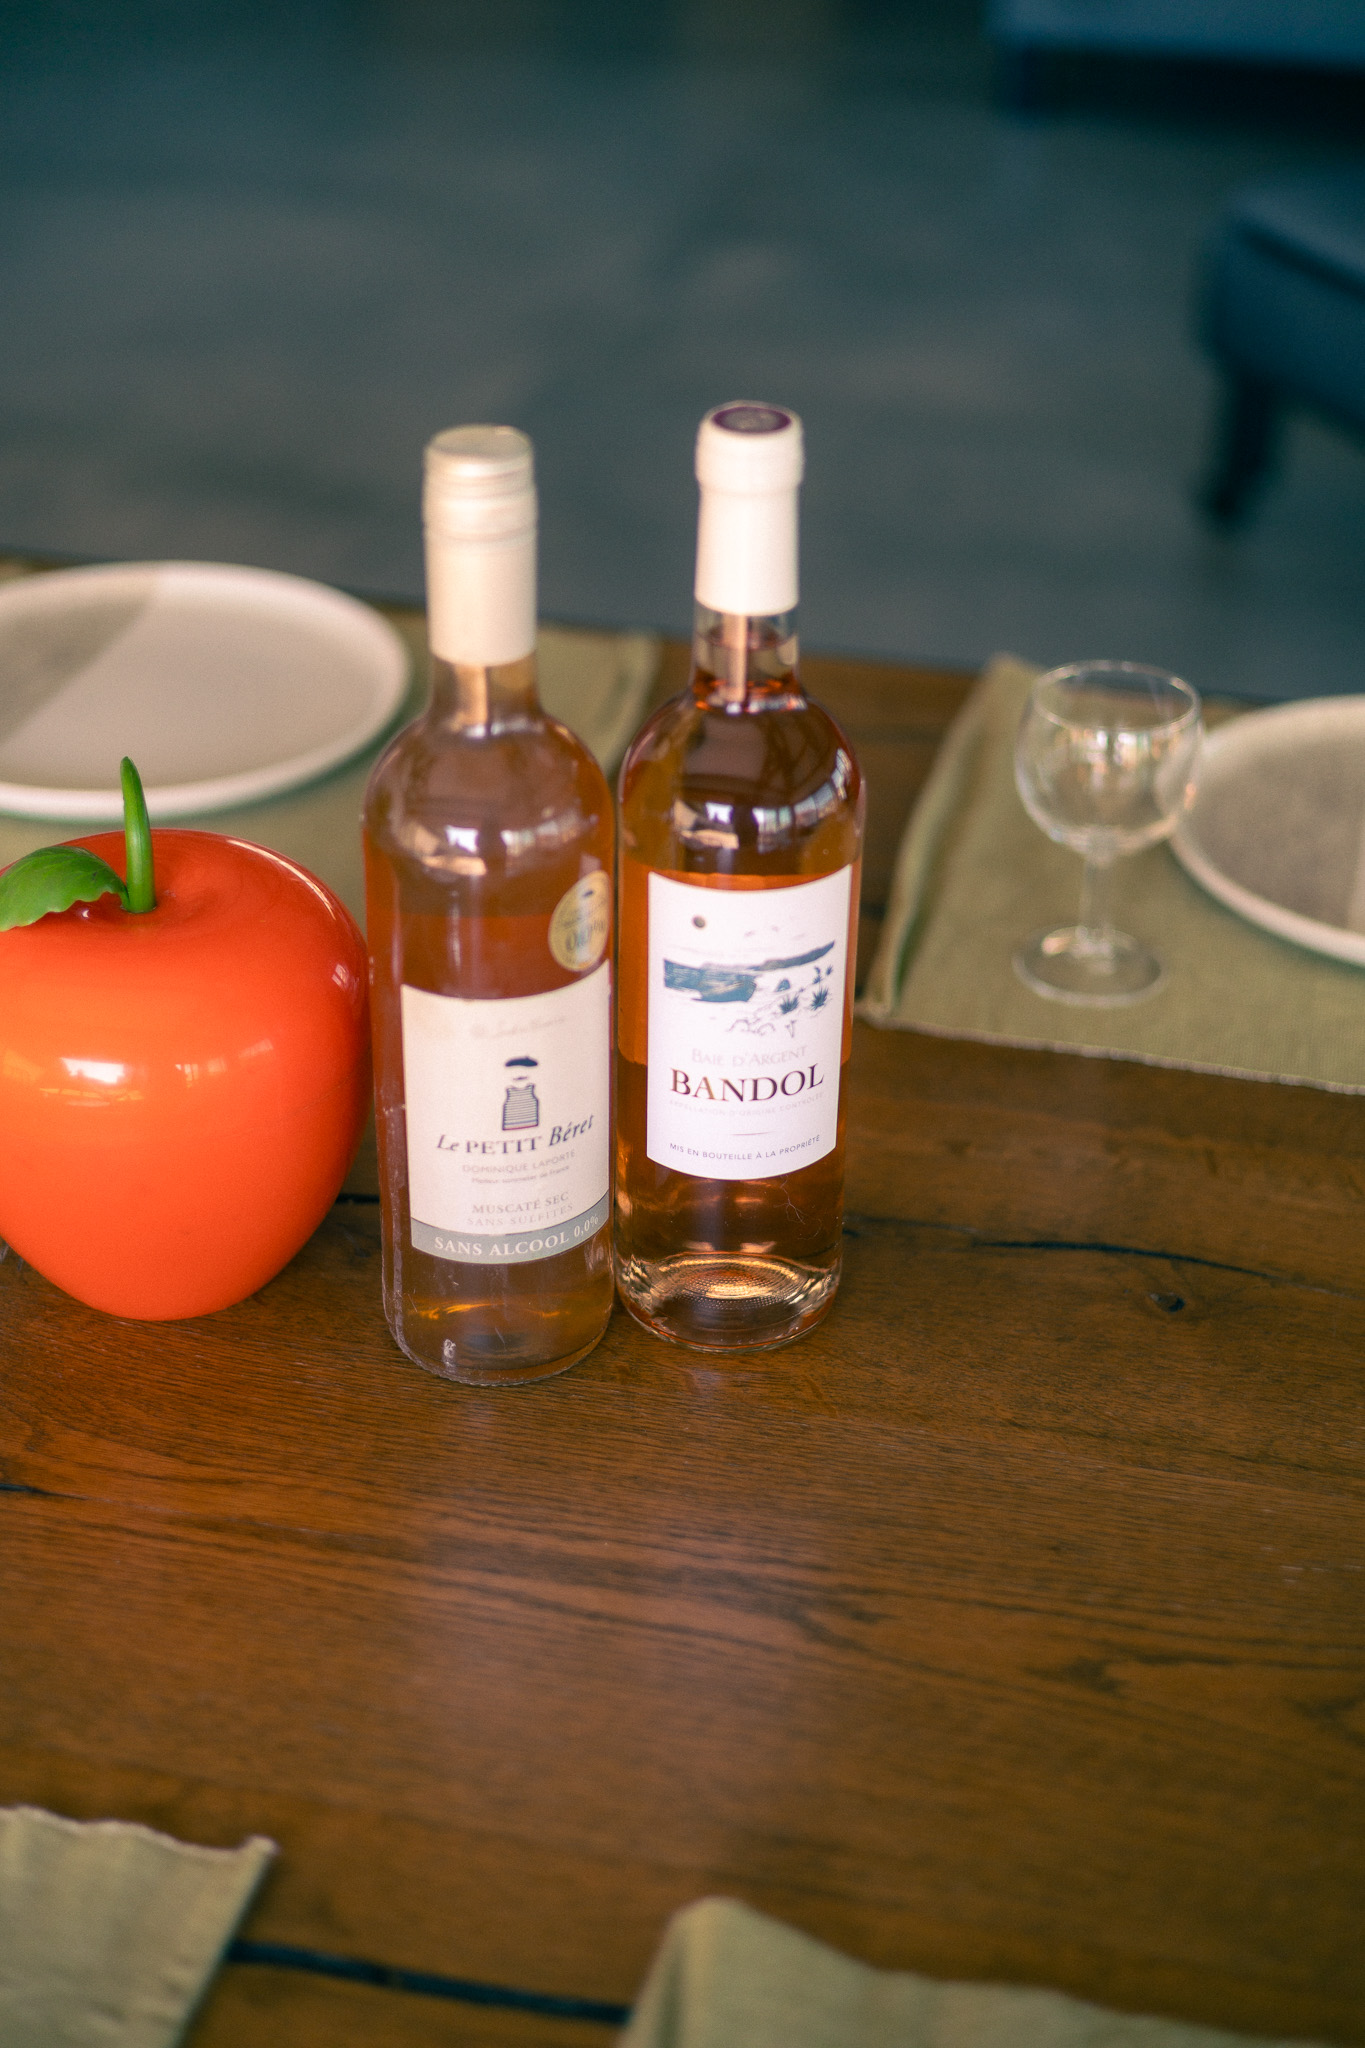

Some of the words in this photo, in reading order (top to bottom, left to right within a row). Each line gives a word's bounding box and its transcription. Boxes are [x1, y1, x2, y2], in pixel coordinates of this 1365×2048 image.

[691, 1047, 724, 1066] BAIE
[670, 1063, 825, 1102] BANDOL
[436, 1133, 460, 1152] Le
[465, 1136, 543, 1155] PETIT
[548, 1114, 595, 1147] Béret
[669, 1142, 684, 1153] MIS
[687, 1148, 699, 1157] EN
[702, 1151, 753, 1160] BOUTEILLE
[755, 1151, 762, 1159] À
[765, 1150, 777, 1158] LA
[779, 1134, 821, 1155] PROPRIÉTÉ
[462, 1163, 528, 1175] DOMINIQUE
[532, 1149, 575, 1169] LAPORTE
[544, 1191, 570, 1207] SEC
[466, 1217, 504, 1227] SANS
[509, 1202, 574, 1225] SULFITES
[434, 1236, 482, 1256] SANS
[489, 1232, 570, 1257] ALCOOL
[574, 1214, 599, 1238] 0,0%
